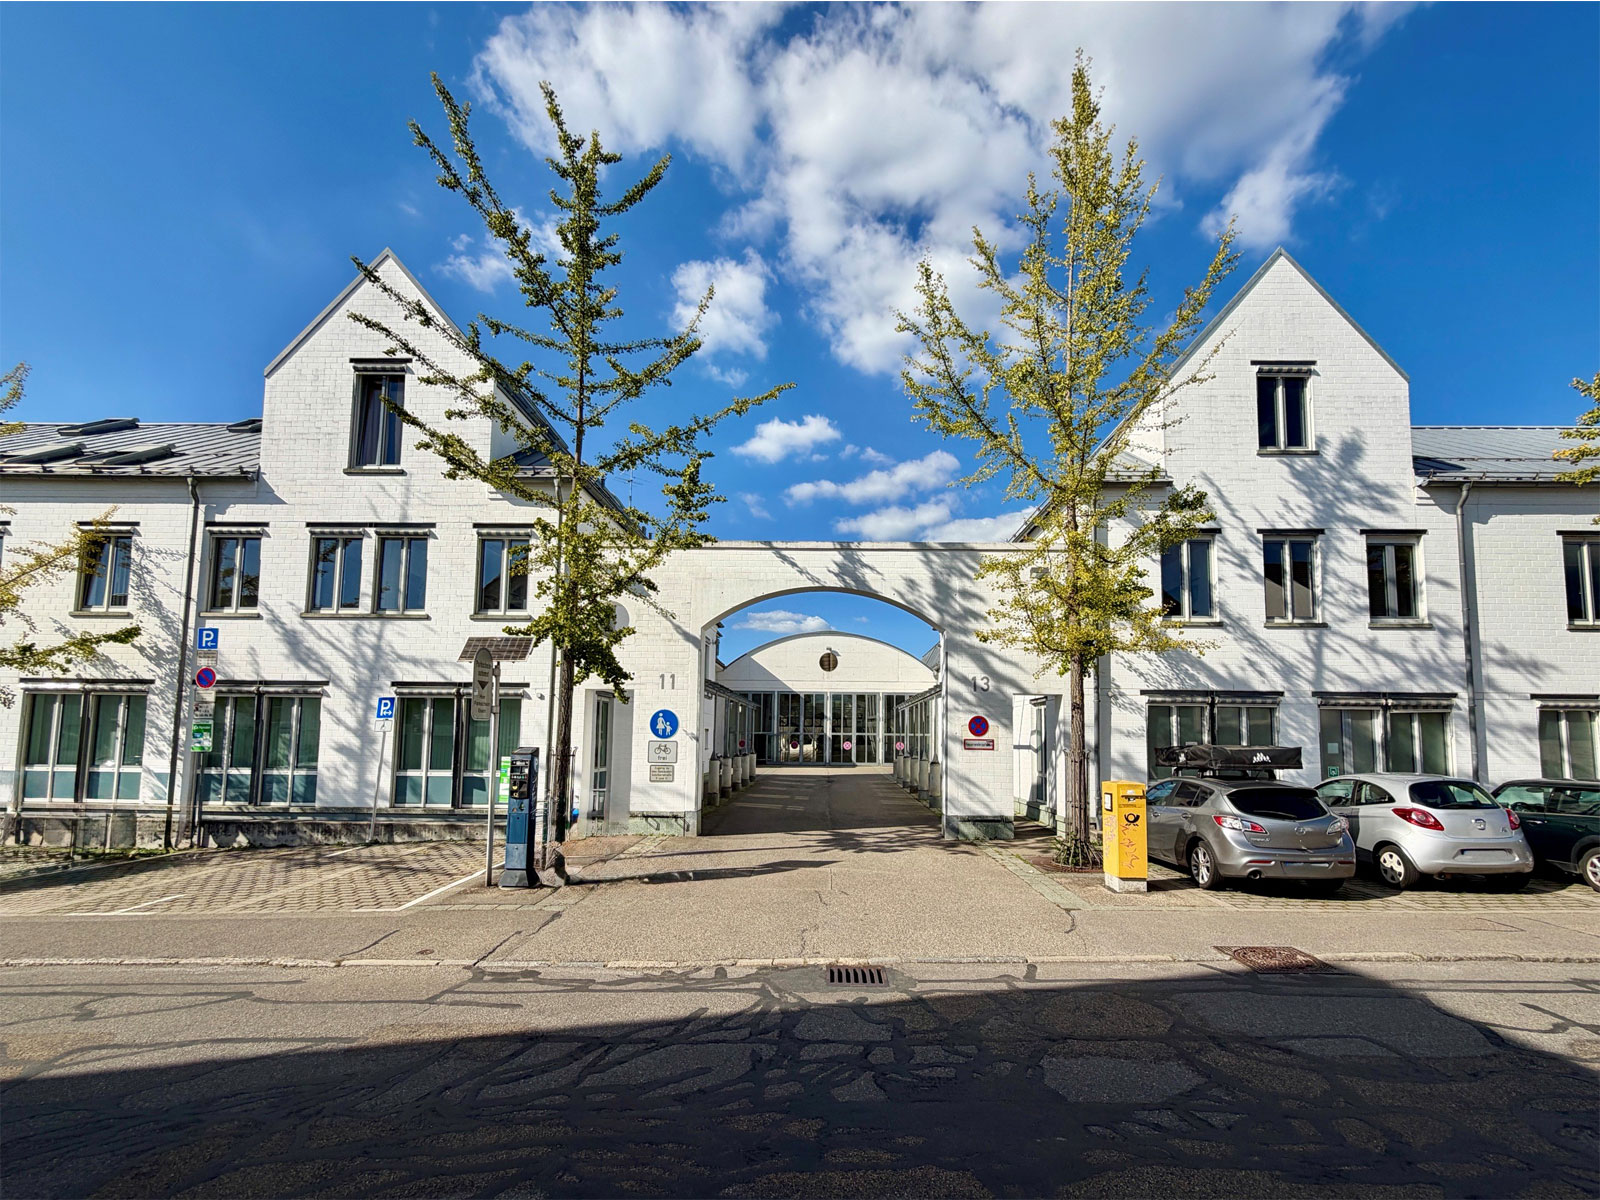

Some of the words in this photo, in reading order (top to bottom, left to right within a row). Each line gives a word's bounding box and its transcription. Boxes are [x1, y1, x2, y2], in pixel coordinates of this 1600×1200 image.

[202, 630, 214, 647] P
[660, 673, 675, 690] 11
[972, 676, 990, 692] 13
[380, 699, 391, 716] P
